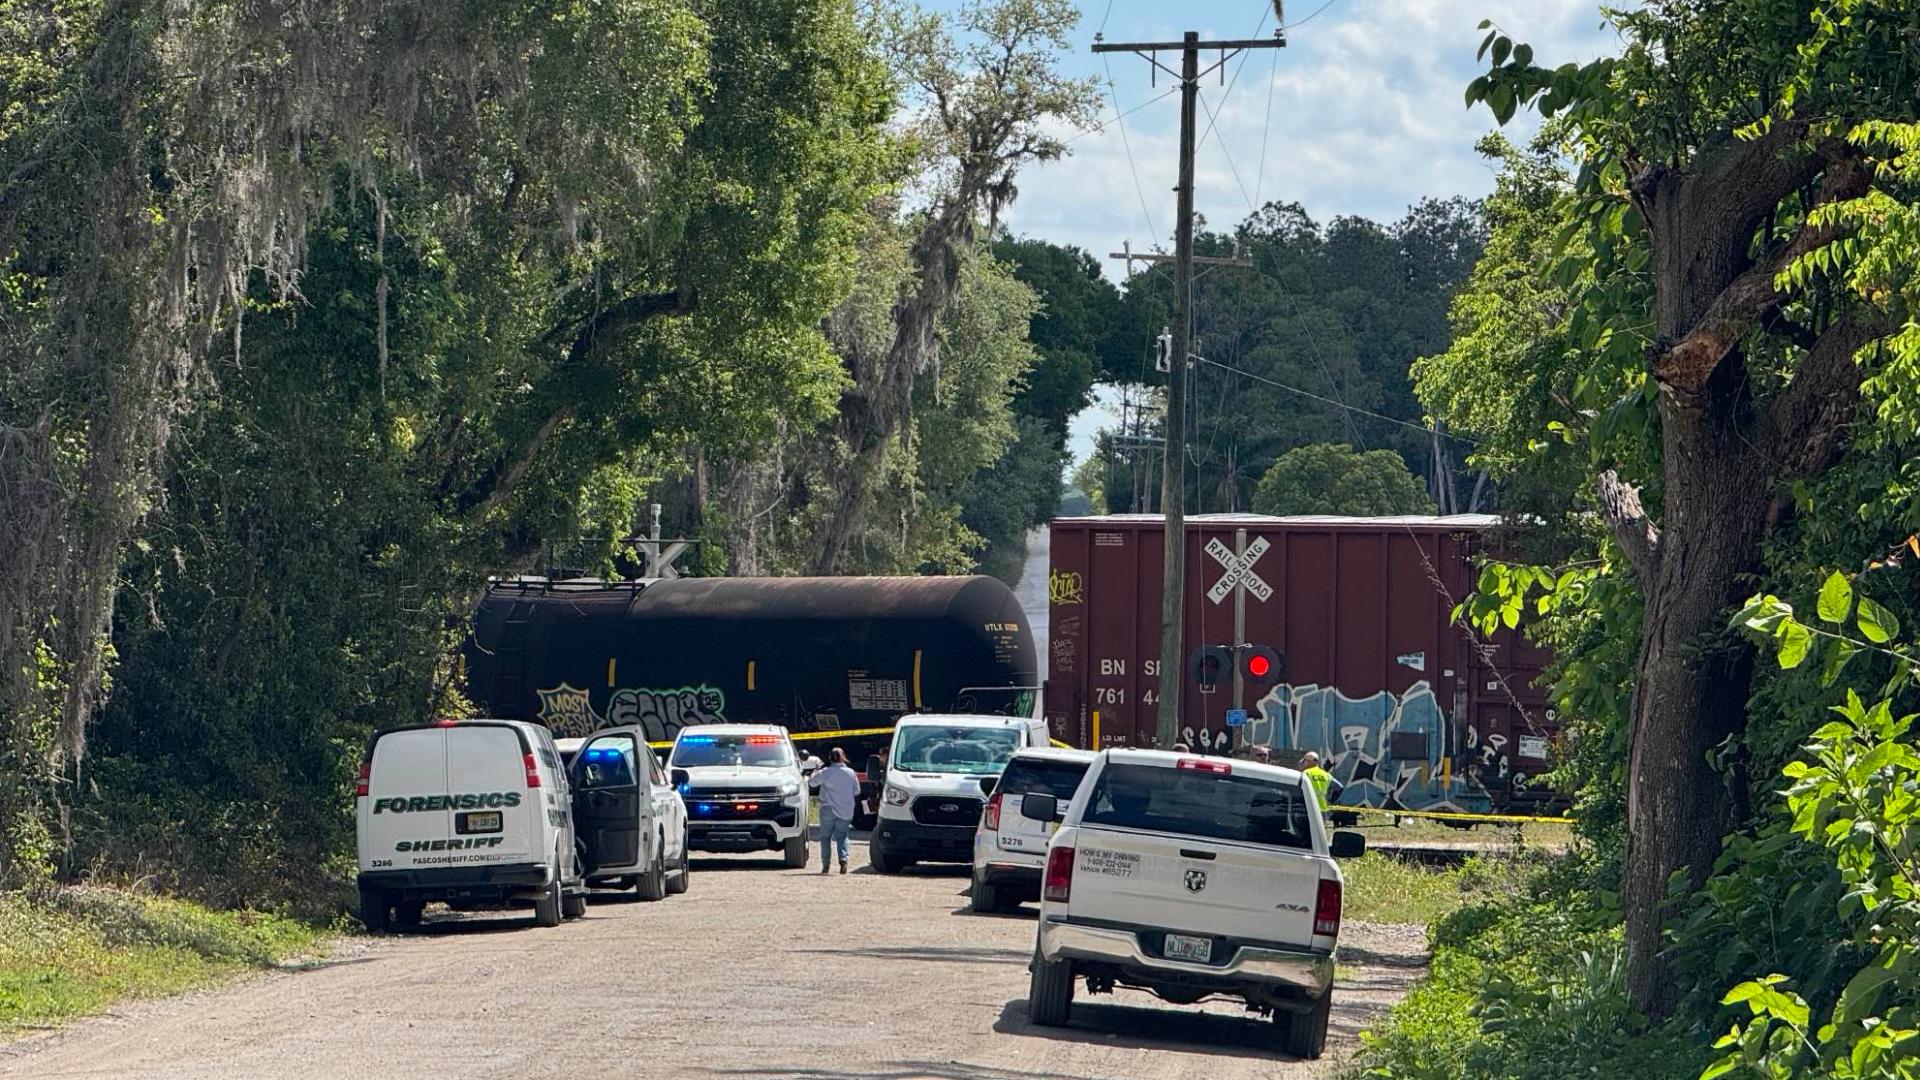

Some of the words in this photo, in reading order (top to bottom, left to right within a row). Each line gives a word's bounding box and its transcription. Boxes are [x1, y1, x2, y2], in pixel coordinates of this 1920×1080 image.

[1208, 541, 1233, 568] RAIL
[1242, 572, 1270, 600] ROAD
[1214, 543, 1264, 597] CROSSING
[1101, 659, 1125, 676] BN
[549, 693, 586, 713] MOST
[1096, 687, 1125, 704] 761
[548, 712, 594, 733] FRESH
[1102, 735, 1112, 743] LD
[1114, 735, 1126, 744] LMT
[373, 792, 521, 815] FORENSICS
[395, 836, 504, 852] SHERIFF
[1001, 837, 1023, 847] 5276
[1103, 850, 1113, 859] MY
[1114, 851, 1141, 863] DRIVING
